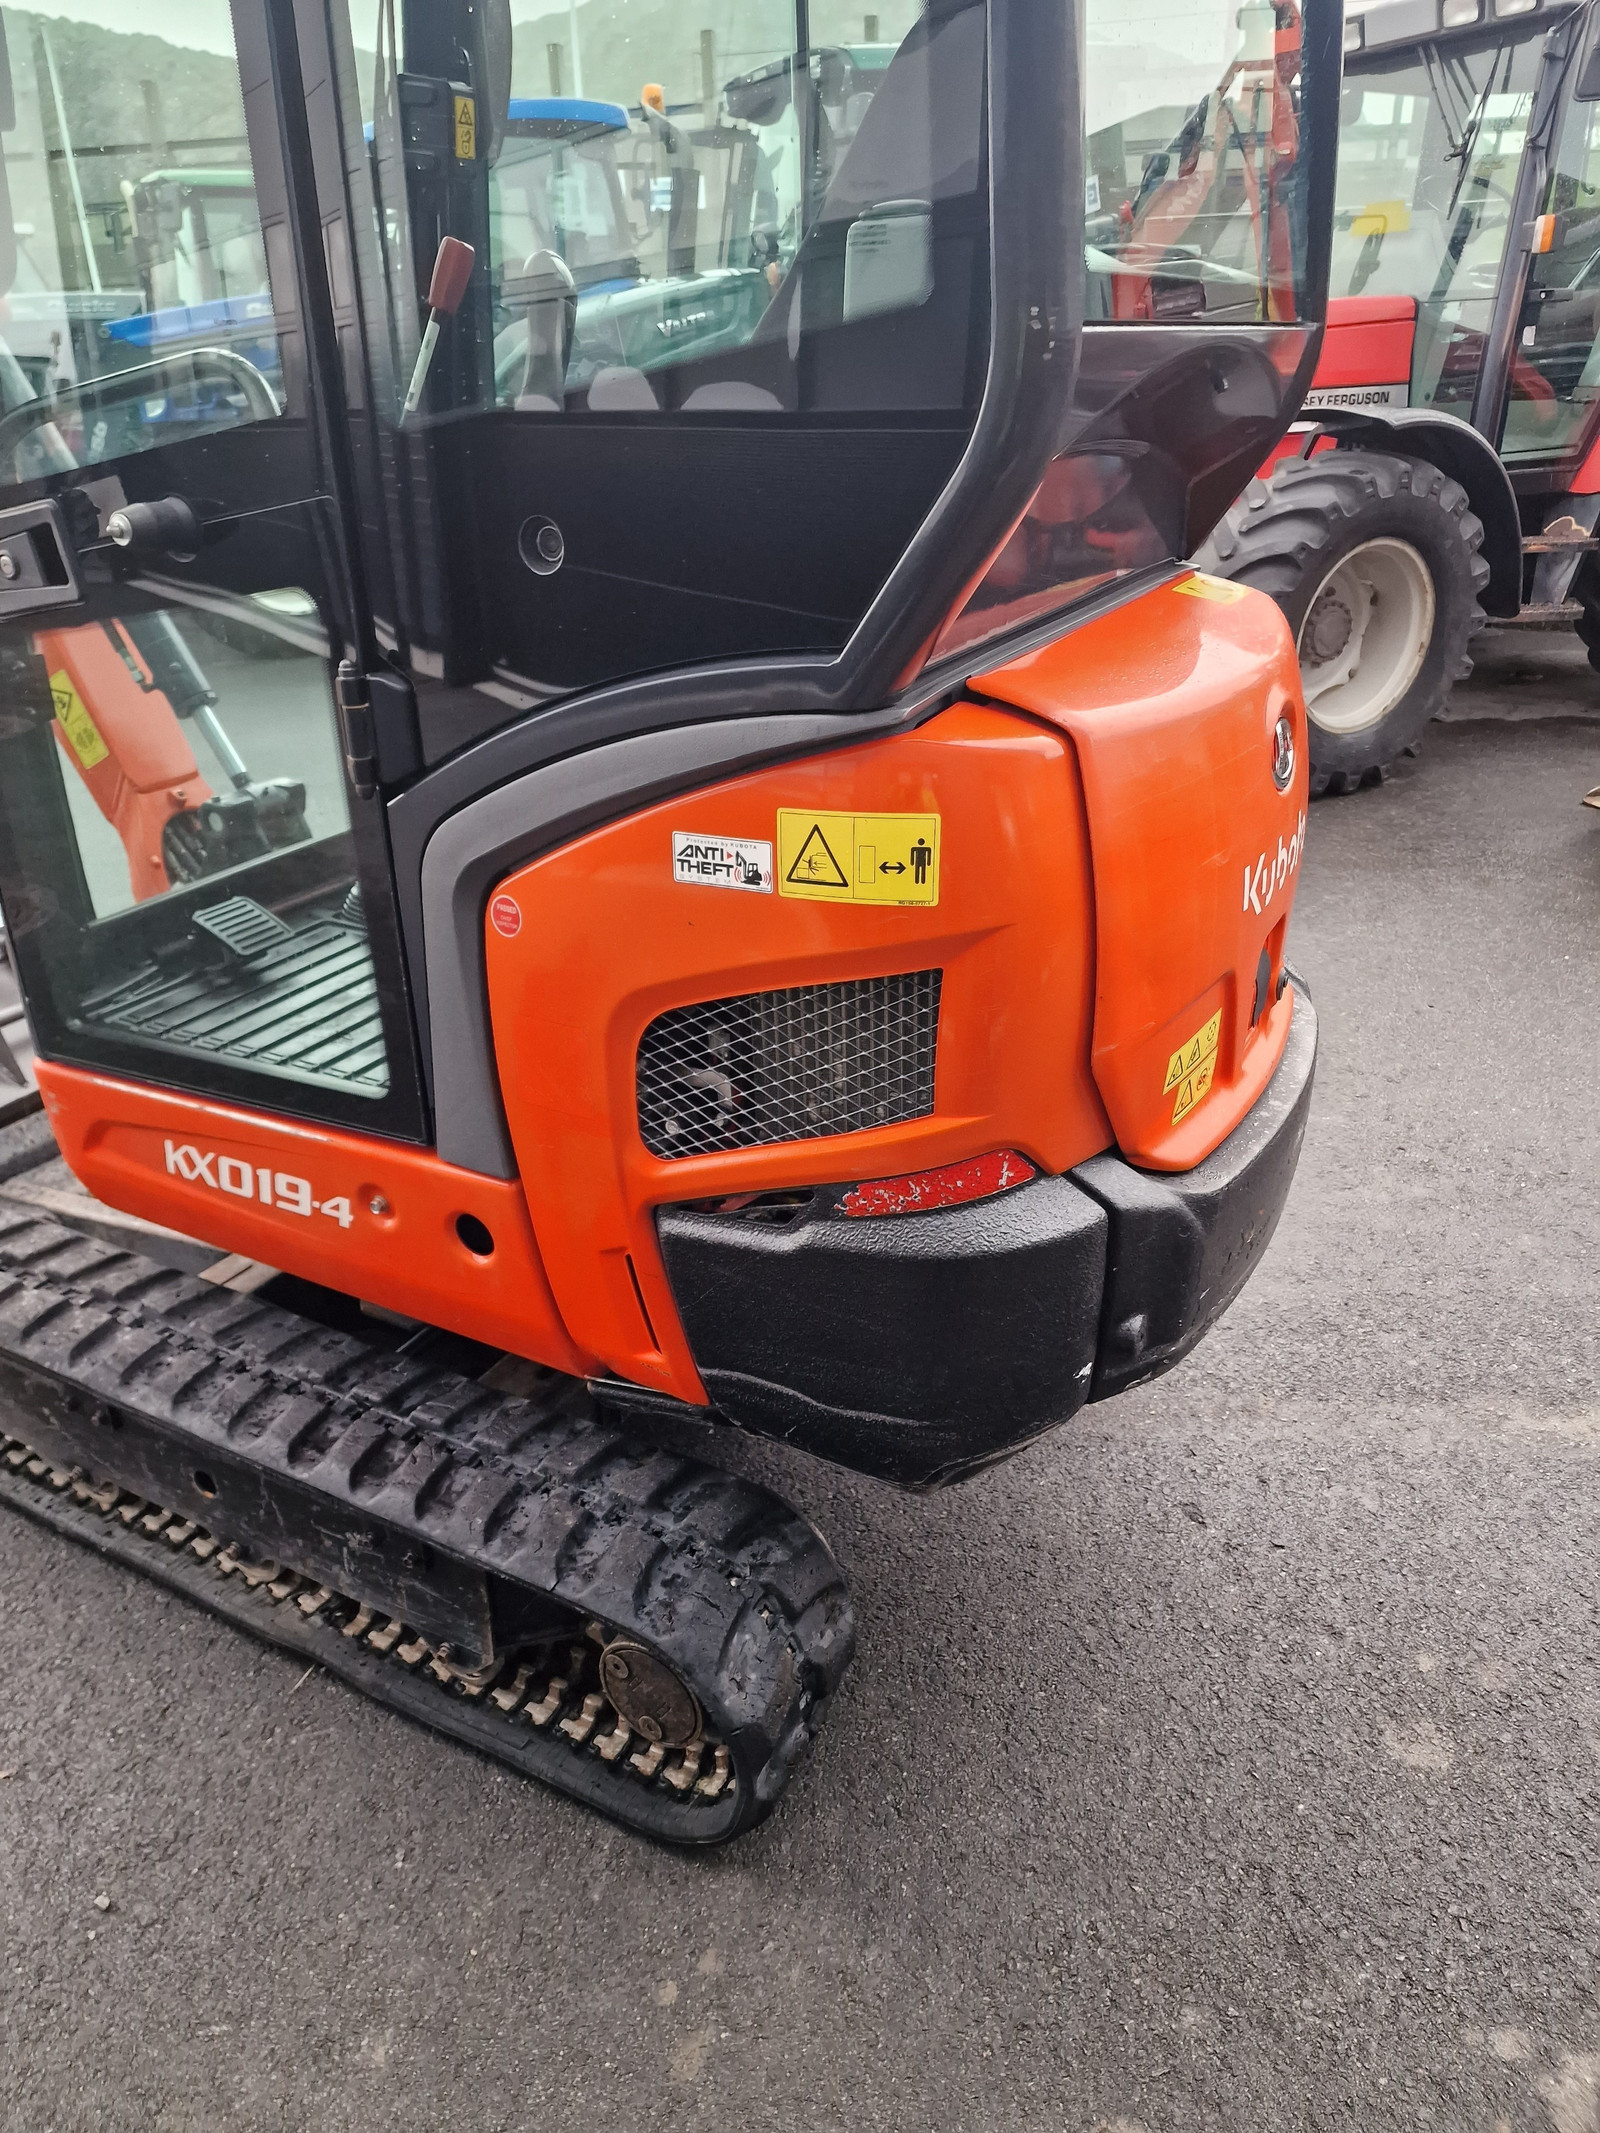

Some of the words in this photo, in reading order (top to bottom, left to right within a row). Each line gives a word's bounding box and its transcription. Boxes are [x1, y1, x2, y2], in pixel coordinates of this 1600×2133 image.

[1326, 391, 1390, 406] FERGUSON
[686, 837, 719, 846] Protected
[677, 844, 724, 862] ANTI
[677, 858, 734, 877] THEFT
[679, 874, 732, 884] SYSTEM
[163, 1139, 355, 1229] KX019-4
